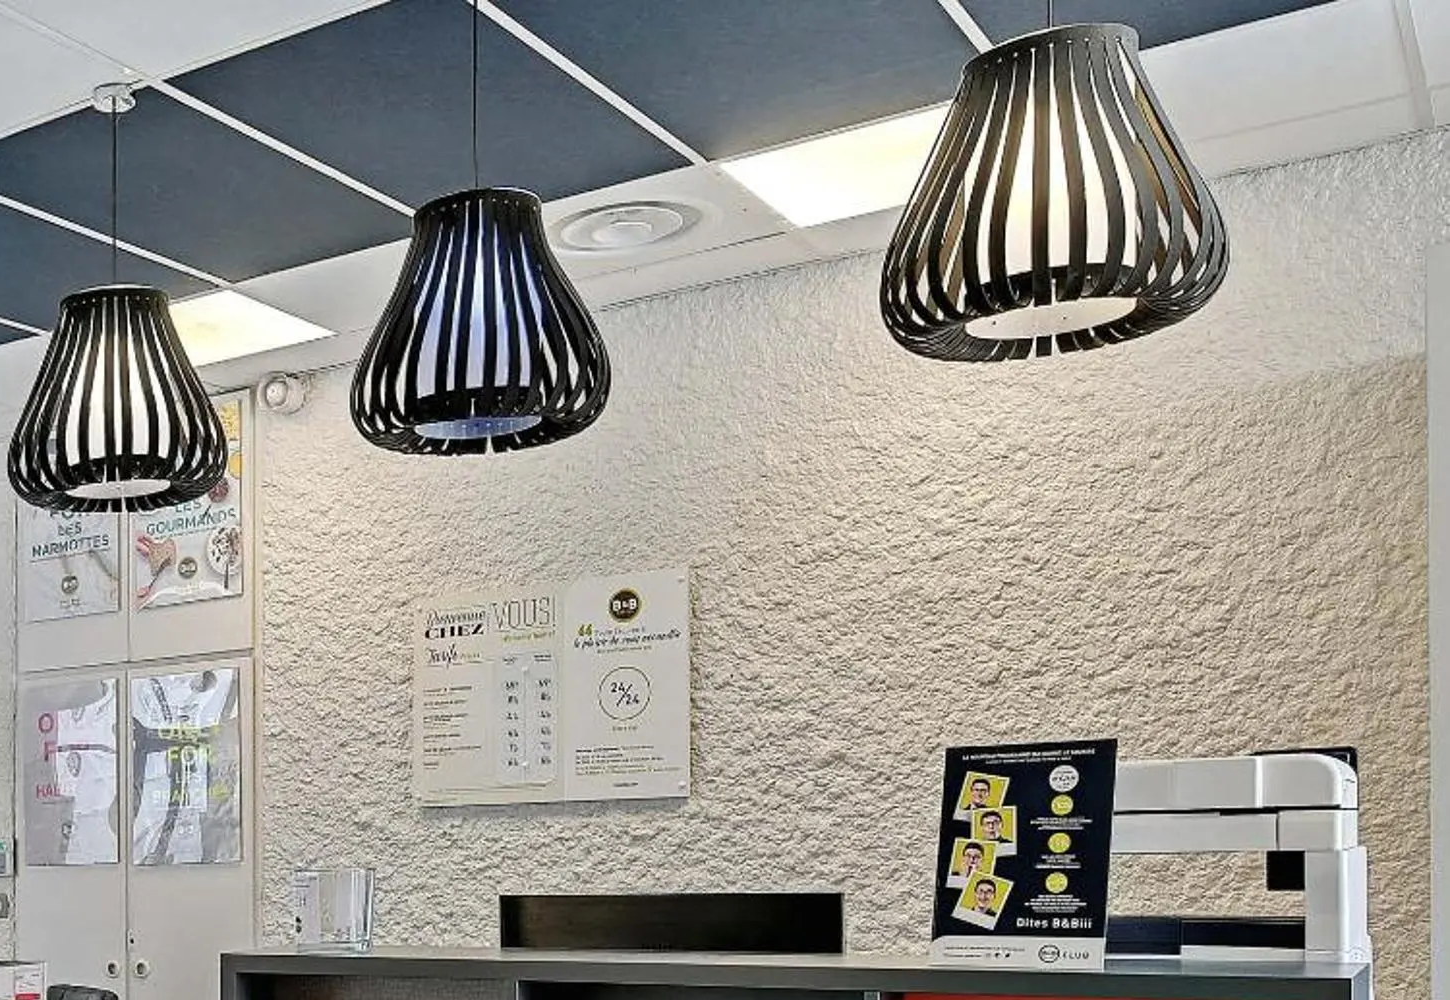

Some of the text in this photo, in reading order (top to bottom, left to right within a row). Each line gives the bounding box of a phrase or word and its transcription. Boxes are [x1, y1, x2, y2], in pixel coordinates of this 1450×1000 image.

[146, 507, 237, 536] GOURMANDS
[32, 534, 109, 557] MARMOTTES
[425, 622, 485, 639] CHEZ
[1016, 917, 1049, 929] Dites
